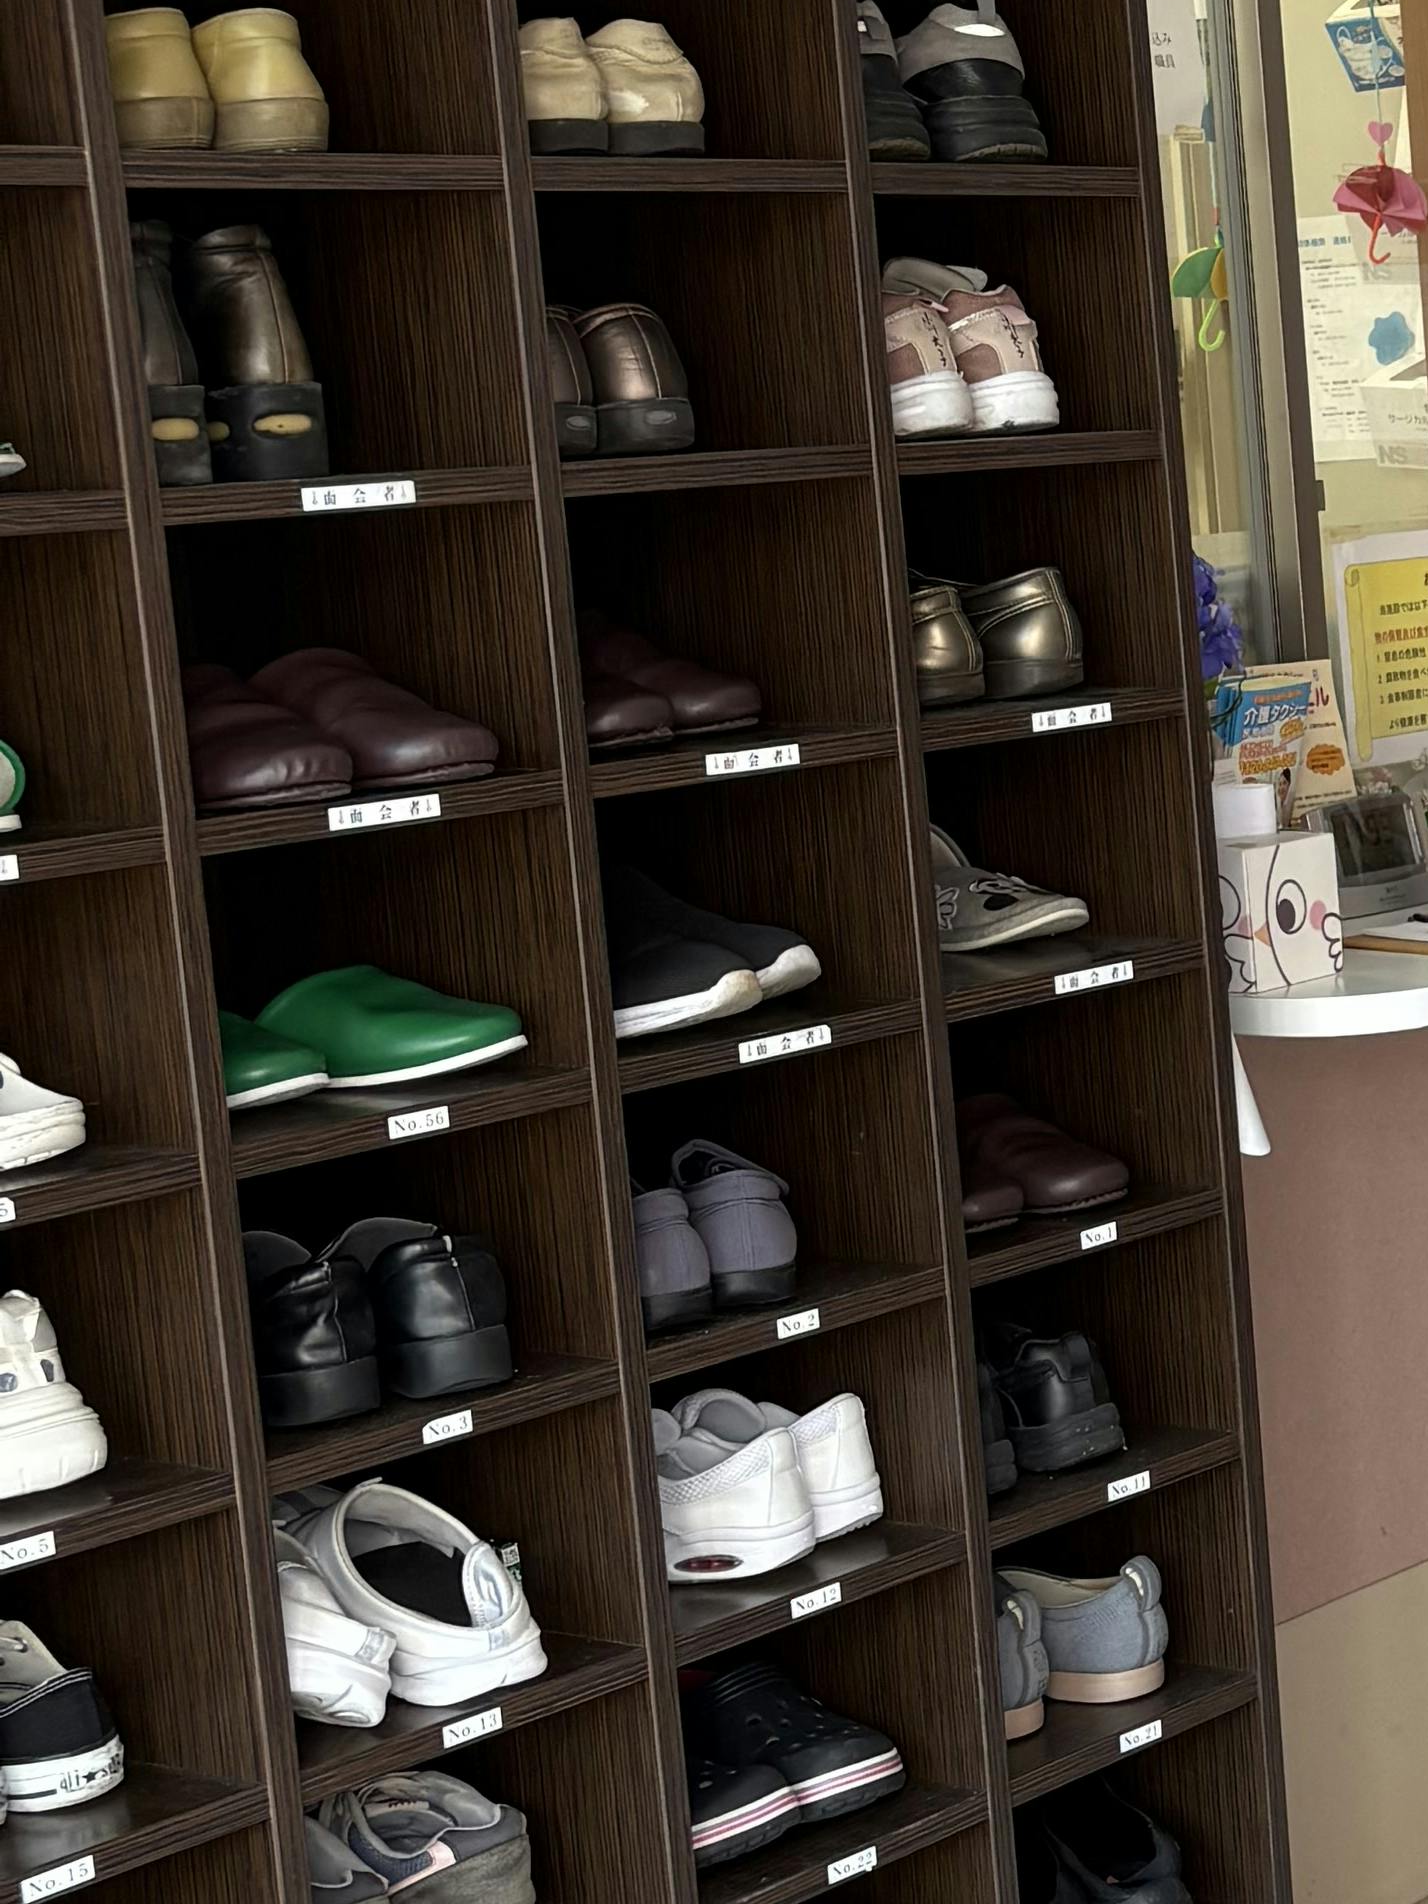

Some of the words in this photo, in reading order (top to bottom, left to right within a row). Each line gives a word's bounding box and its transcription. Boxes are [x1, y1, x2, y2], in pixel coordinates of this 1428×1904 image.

[394, 1112, 444, 1132] No.56
[1085, 1226, 1112, 1244] No.1
[781, 1313, 815, 1332] No.2
[428, 1415, 468, 1436] No.3
[1111, 1475, 1145, 1495] No.11
[795, 1588, 837, 1611] No.12
[448, 1713, 497, 1739] No.13
[1124, 1724, 1157, 1746] No.21
[832, 1851, 873, 1876] No.22
[29, 1862, 89, 1893] No.15
